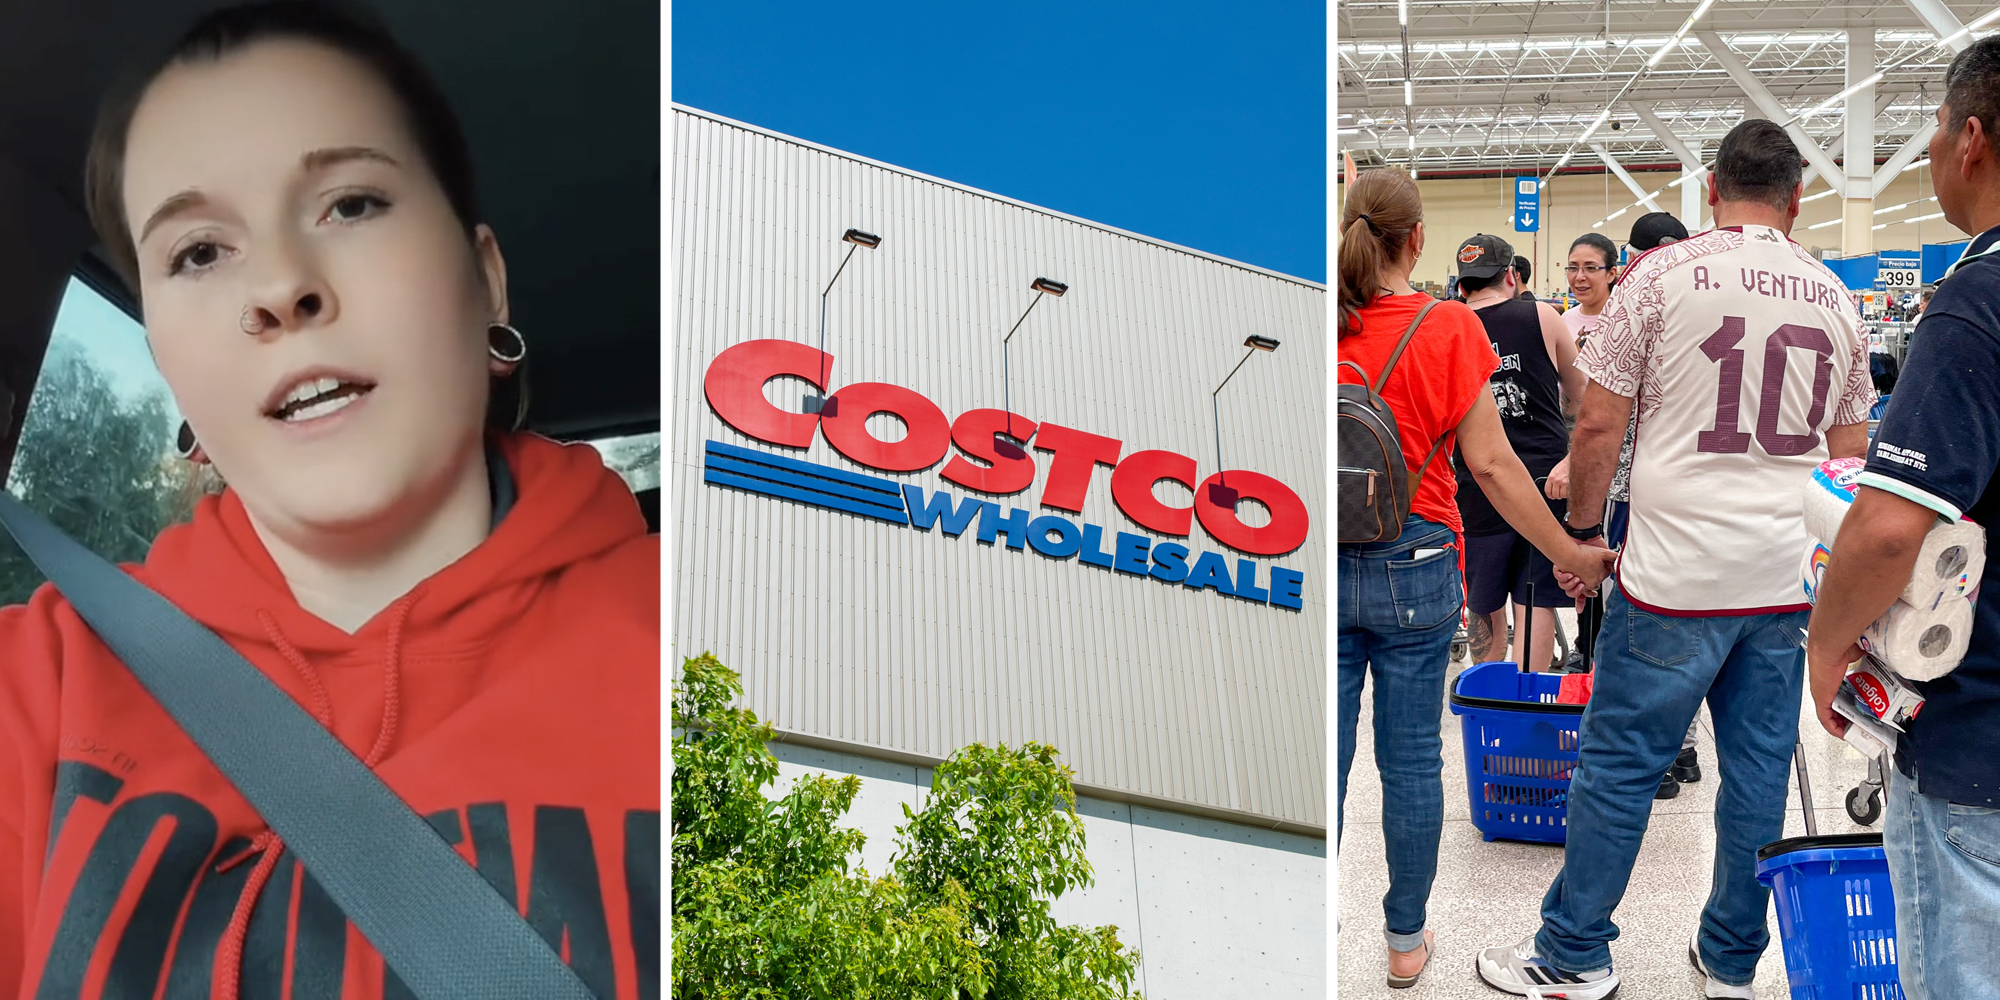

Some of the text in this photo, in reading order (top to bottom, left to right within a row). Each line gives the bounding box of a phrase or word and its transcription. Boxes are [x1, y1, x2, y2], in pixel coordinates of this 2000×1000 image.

[1740, 267, 1842, 312] VENTURA
[704, 338, 1310, 556] COSTCO
[1696, 315, 1835, 457] 10
[901, 483, 1304, 611] WHOLESALE
[1855, 675, 1886, 713] Colgate
